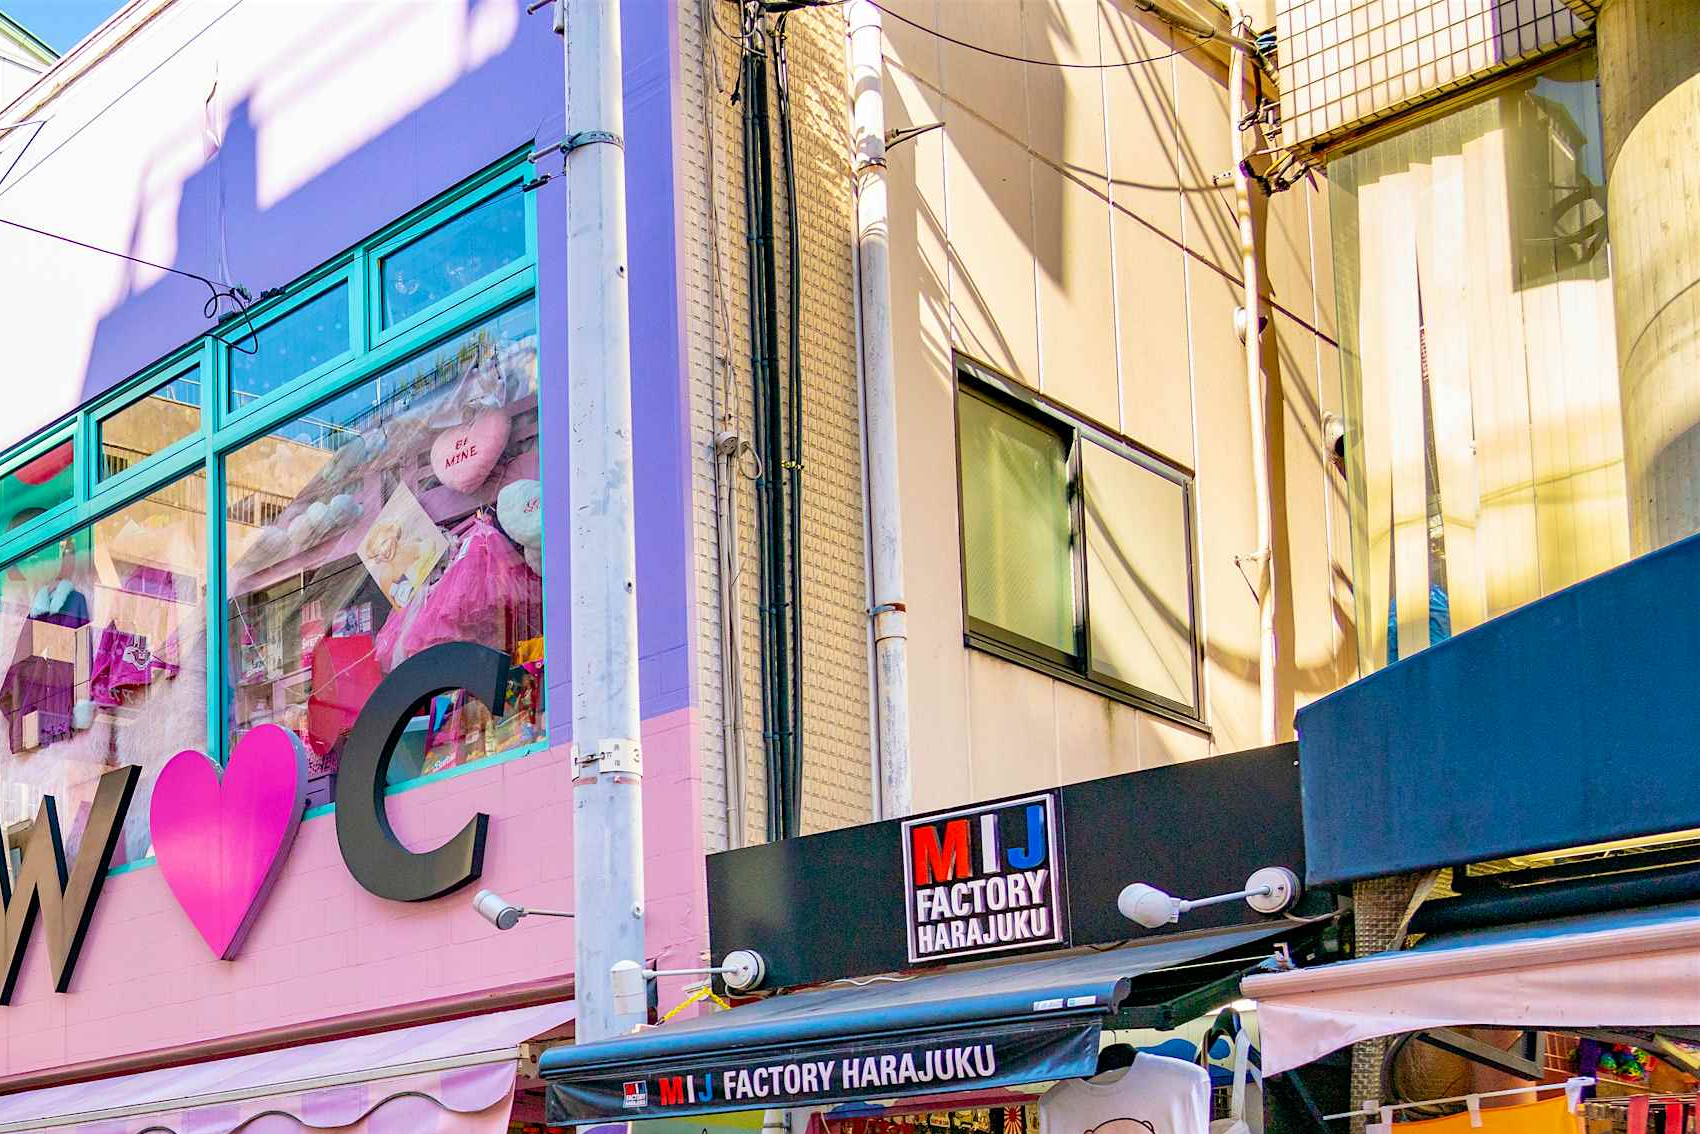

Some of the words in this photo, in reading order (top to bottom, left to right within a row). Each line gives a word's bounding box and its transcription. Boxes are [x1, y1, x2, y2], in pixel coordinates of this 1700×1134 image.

[445, 446, 478, 469] MINE
[335, 641, 509, 902] C
[912, 803, 1047, 887] MIJ
[916, 869, 1047, 921] FACTORY
[918, 907, 1049, 955] HARAJUKU
[659, 1073, 714, 1106] MIJ
[723, 1059, 836, 1100] FACTORY
[842, 1044, 996, 1090] HARAJUKU
